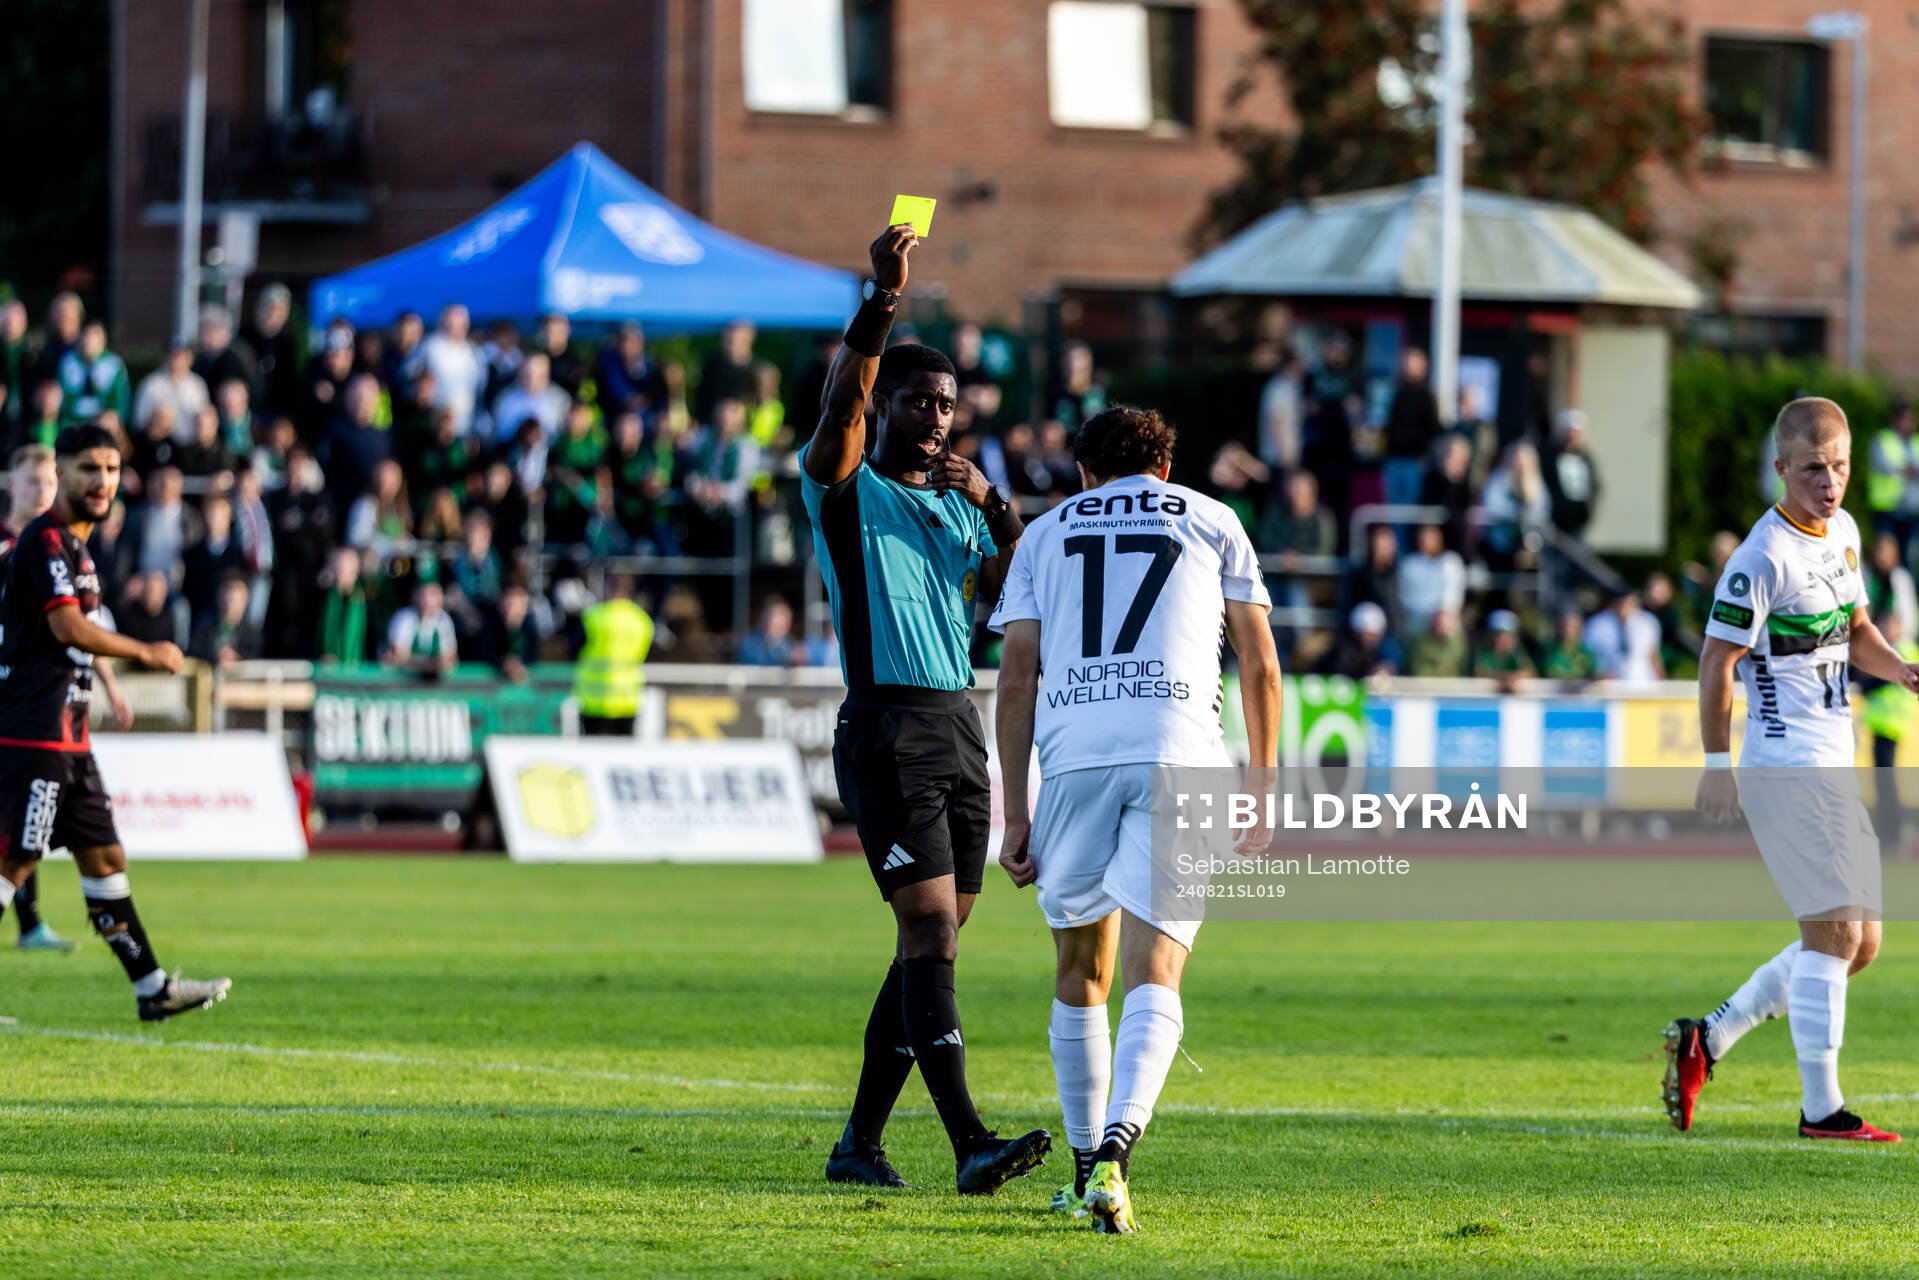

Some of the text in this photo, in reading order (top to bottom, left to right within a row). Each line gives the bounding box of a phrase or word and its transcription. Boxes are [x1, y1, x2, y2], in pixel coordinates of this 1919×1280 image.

[1059, 490, 1187, 523] renta
[1069, 519, 1173, 531] MASKINUTHYRNING
[1064, 534, 1183, 658] 17
[1068, 660, 1164, 685] NORDIC
[1047, 681, 1190, 709] WELLNESS
